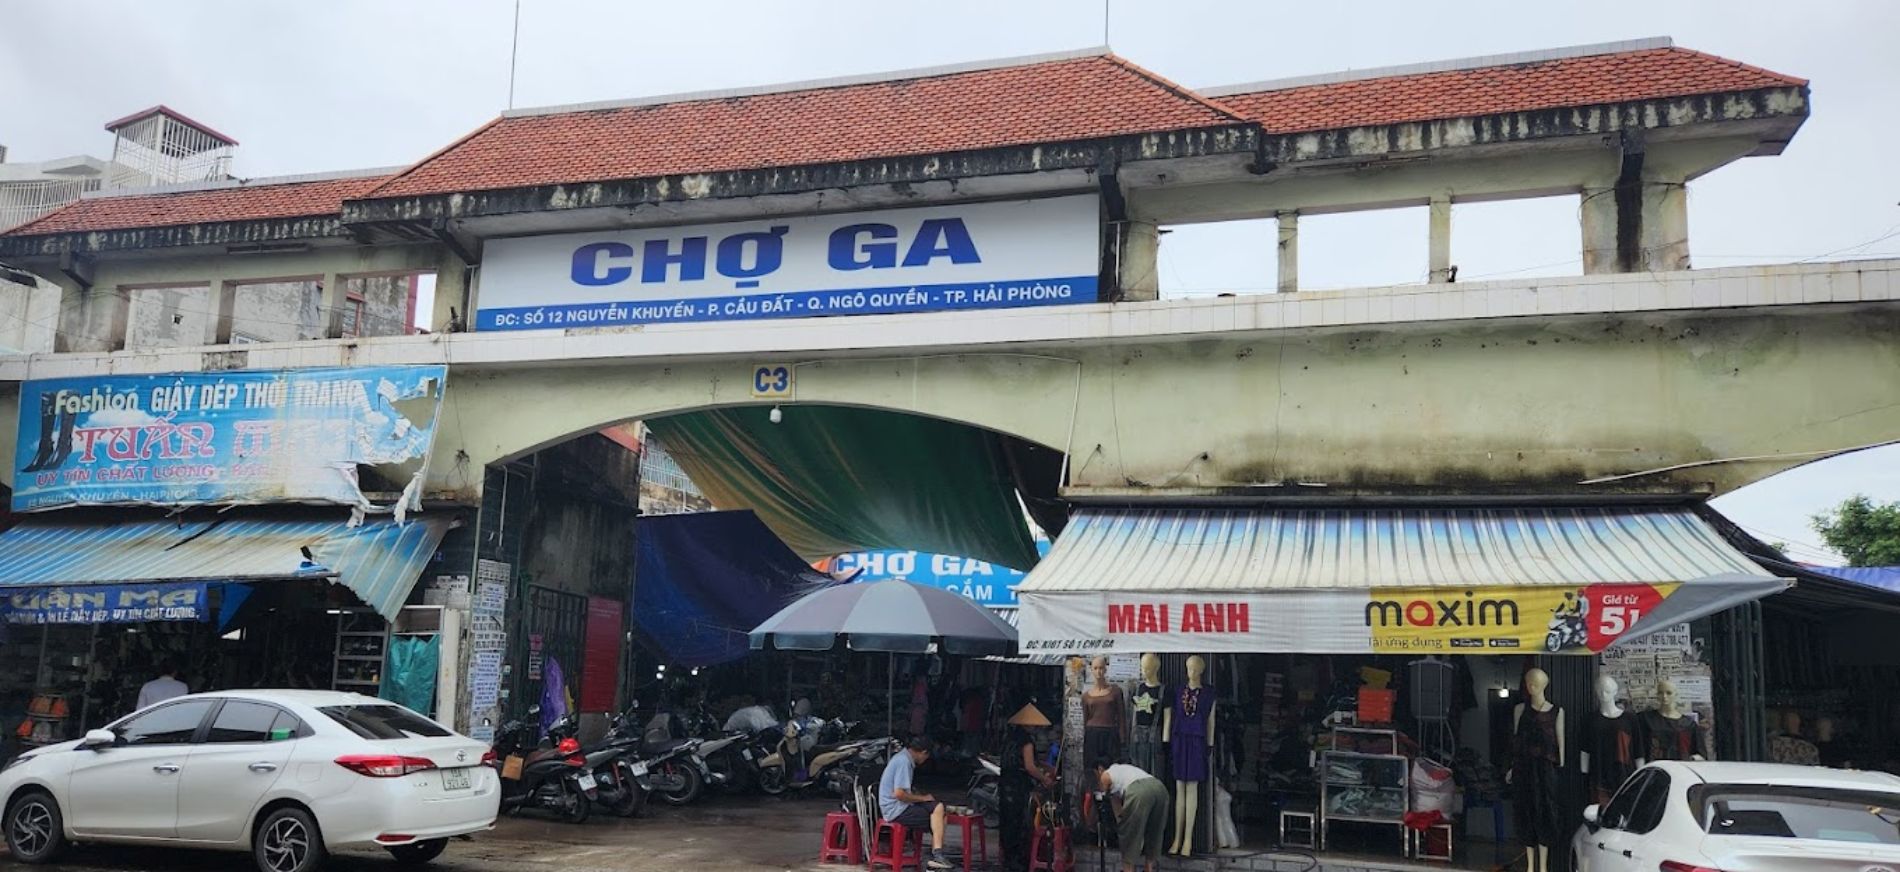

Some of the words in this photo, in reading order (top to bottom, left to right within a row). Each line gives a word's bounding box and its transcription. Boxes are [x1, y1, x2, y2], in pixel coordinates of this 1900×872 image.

[571, 225, 789, 287] CHỢ
[828, 217, 982, 271] GA
[496, 314, 520, 326] ĐC:
[524, 308, 544, 325] SỐ
[548, 312, 562, 323] 12
[567, 305, 627, 322] NGUYỄN
[632, 303, 694, 320] KHUYẾN
[708, 304, 720, 316] P.
[724, 297, 757, 315] CẦU
[762, 294, 793, 312] ĐẤT
[808, 297, 824, 310] Q.
[829, 291, 866, 309] NGÔ
[869, 287, 929, 307] QUYỀN
[944, 290, 967, 303] TP.
[973, 284, 1002, 302] HẢI
[1008, 282, 1072, 300] PHÒNG
[55, 386, 139, 415] Fashion
[201, 379, 238, 410] DÉP
[755, 367, 788, 392] C3
[75, 411, 215, 463] TUẤN
[837, 551, 917, 580] CHỢ
[932, 554, 993, 575] GA
[1108, 604, 1169, 633] MAI
[1181, 602, 1249, 633] ANH
[1365, 590, 1519, 627] maxim
[1603, 594, 1624, 606] Giá
[1626, 593, 1639, 606] từ
